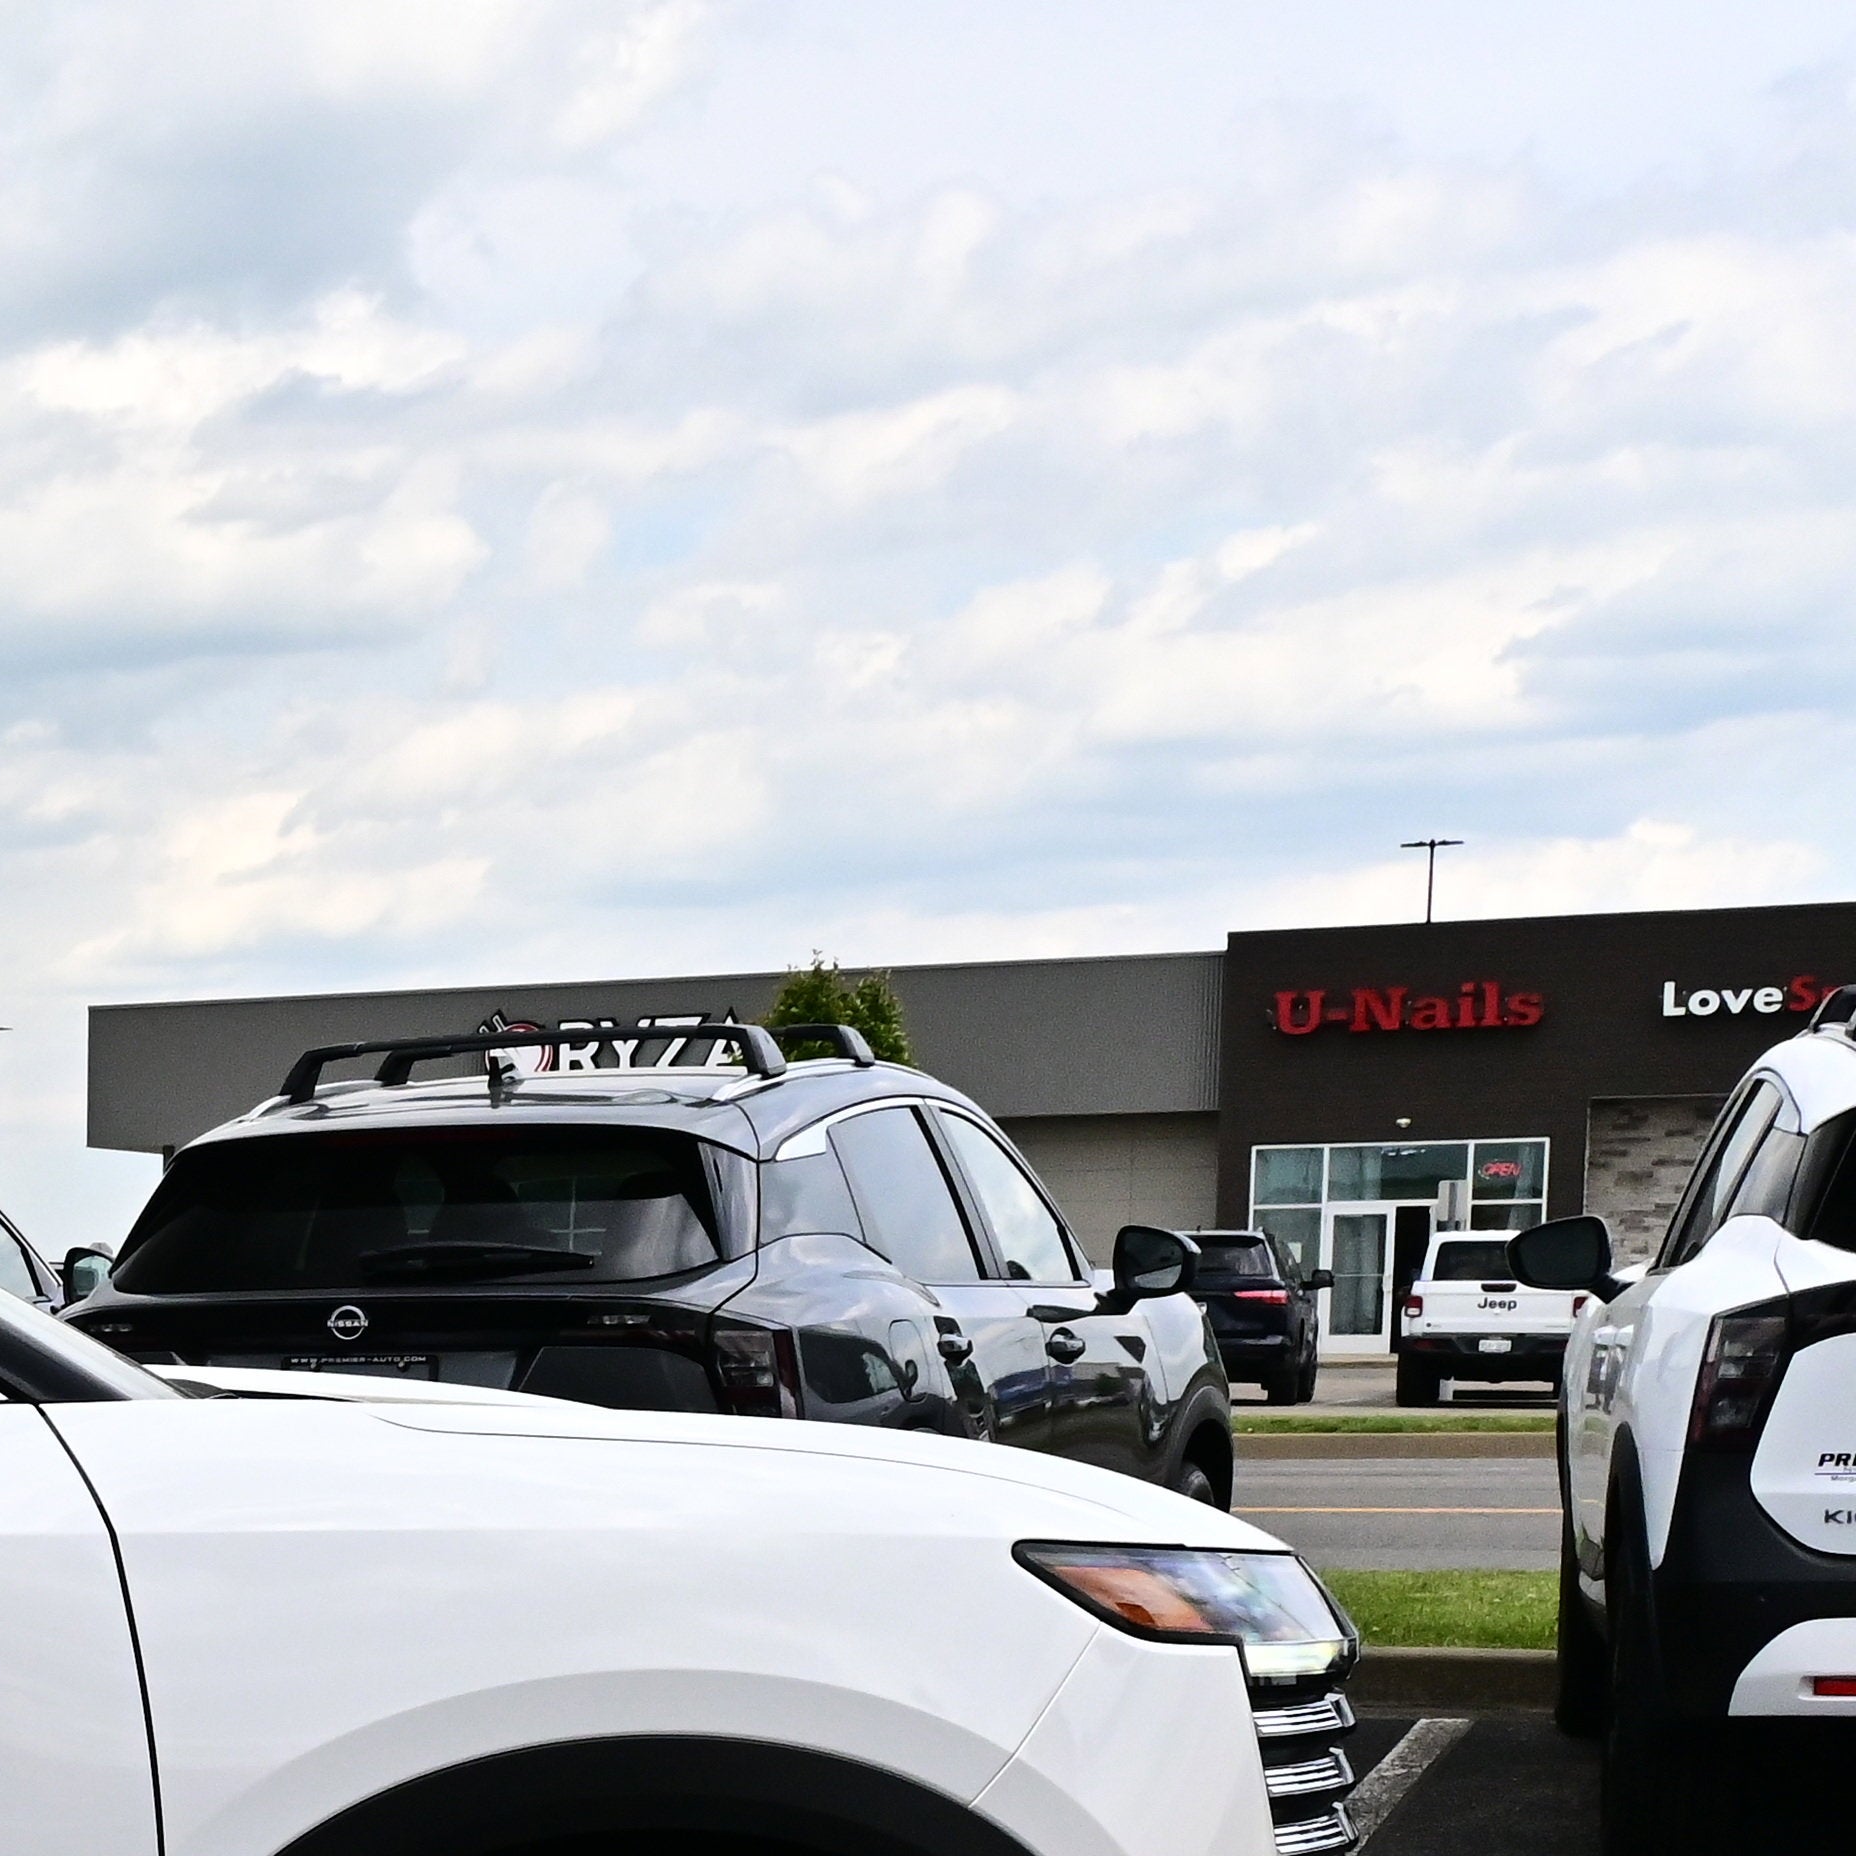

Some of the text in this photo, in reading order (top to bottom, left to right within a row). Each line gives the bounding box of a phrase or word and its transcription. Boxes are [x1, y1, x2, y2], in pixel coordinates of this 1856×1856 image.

[1274, 981, 1545, 1035] U-Nails
[1482, 1162, 1523, 1177] OPEN
[1477, 1297, 1518, 1311] Jeep
[327, 1319, 369, 1328] NISSAN
[1817, 1453, 1856, 1467] PR
[1824, 1509, 1856, 1524] KI
